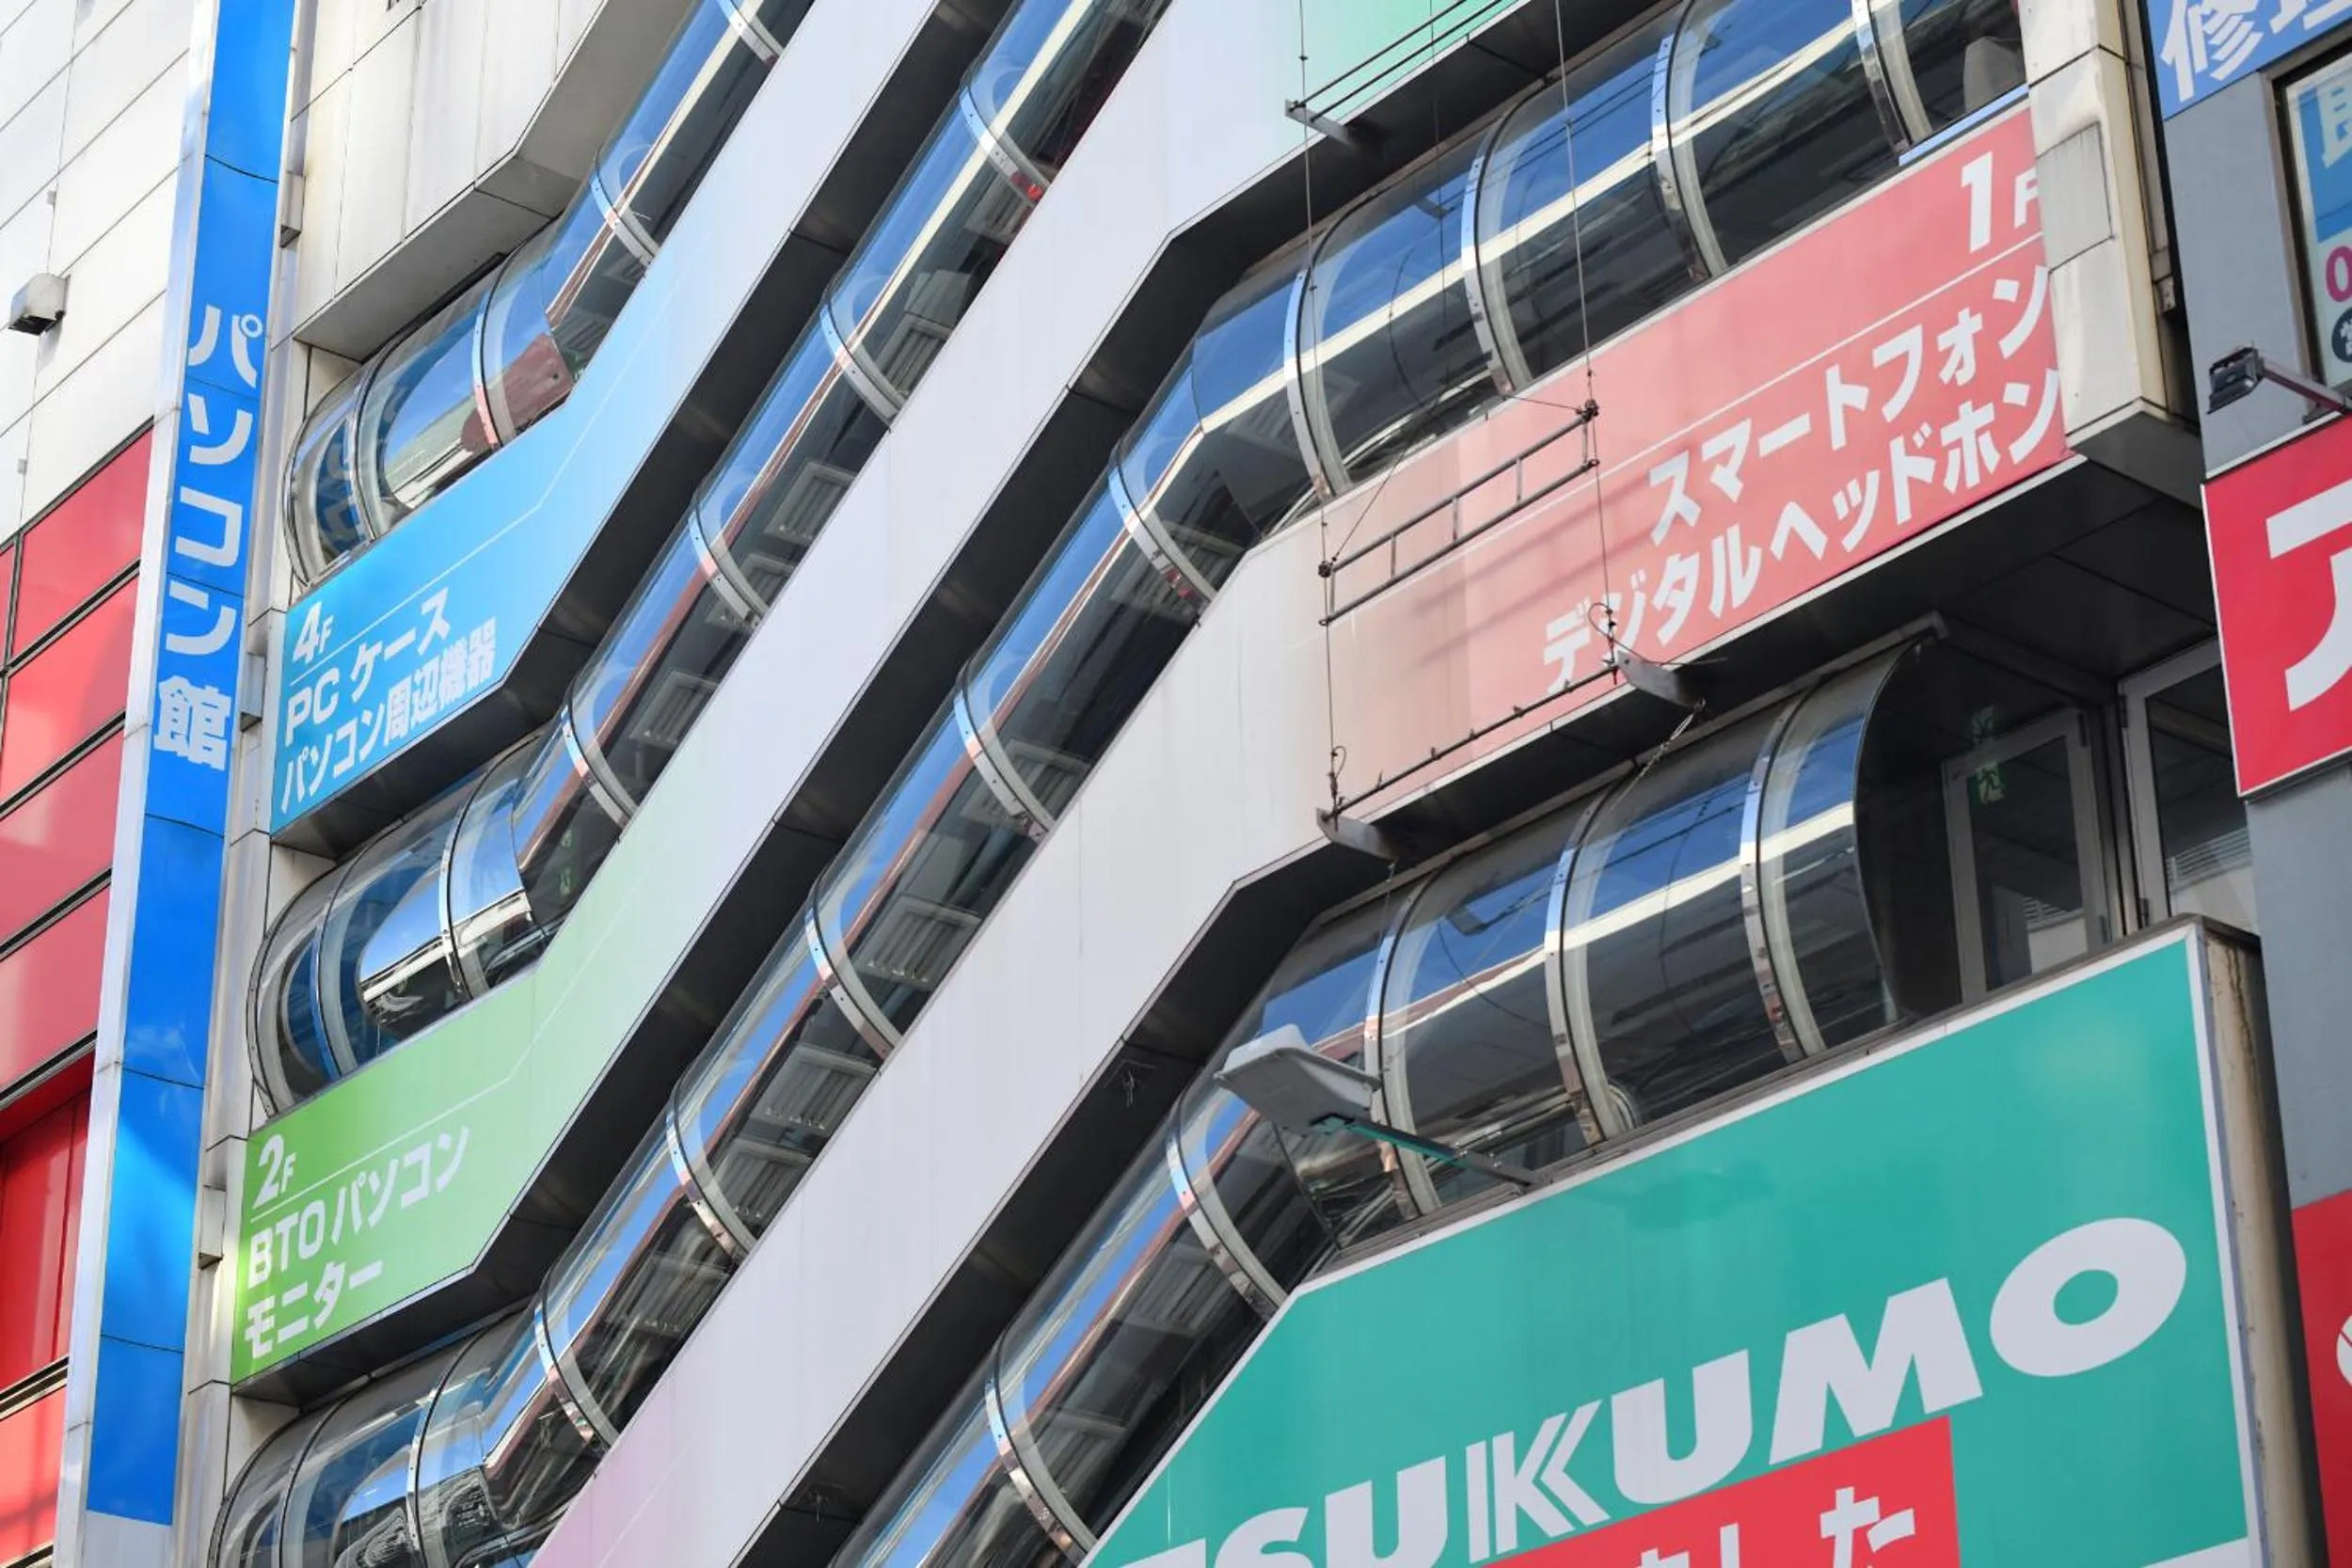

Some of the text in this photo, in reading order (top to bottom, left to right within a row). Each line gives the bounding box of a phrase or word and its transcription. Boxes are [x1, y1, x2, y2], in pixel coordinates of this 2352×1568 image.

[1648, 264, 2051, 546] スマートフォン
[153, 303, 263, 772] パソコン館
[293, 601, 334, 663] 4F
[1543, 367, 2060, 694] デジタルヘッドホン
[281, 616, 496, 814] パソコン周辺機器
[252, 1133, 296, 1210] 2F
[245, 1260, 383, 1359] モニター
[1117, 1217, 2185, 1568] SUKUMO
